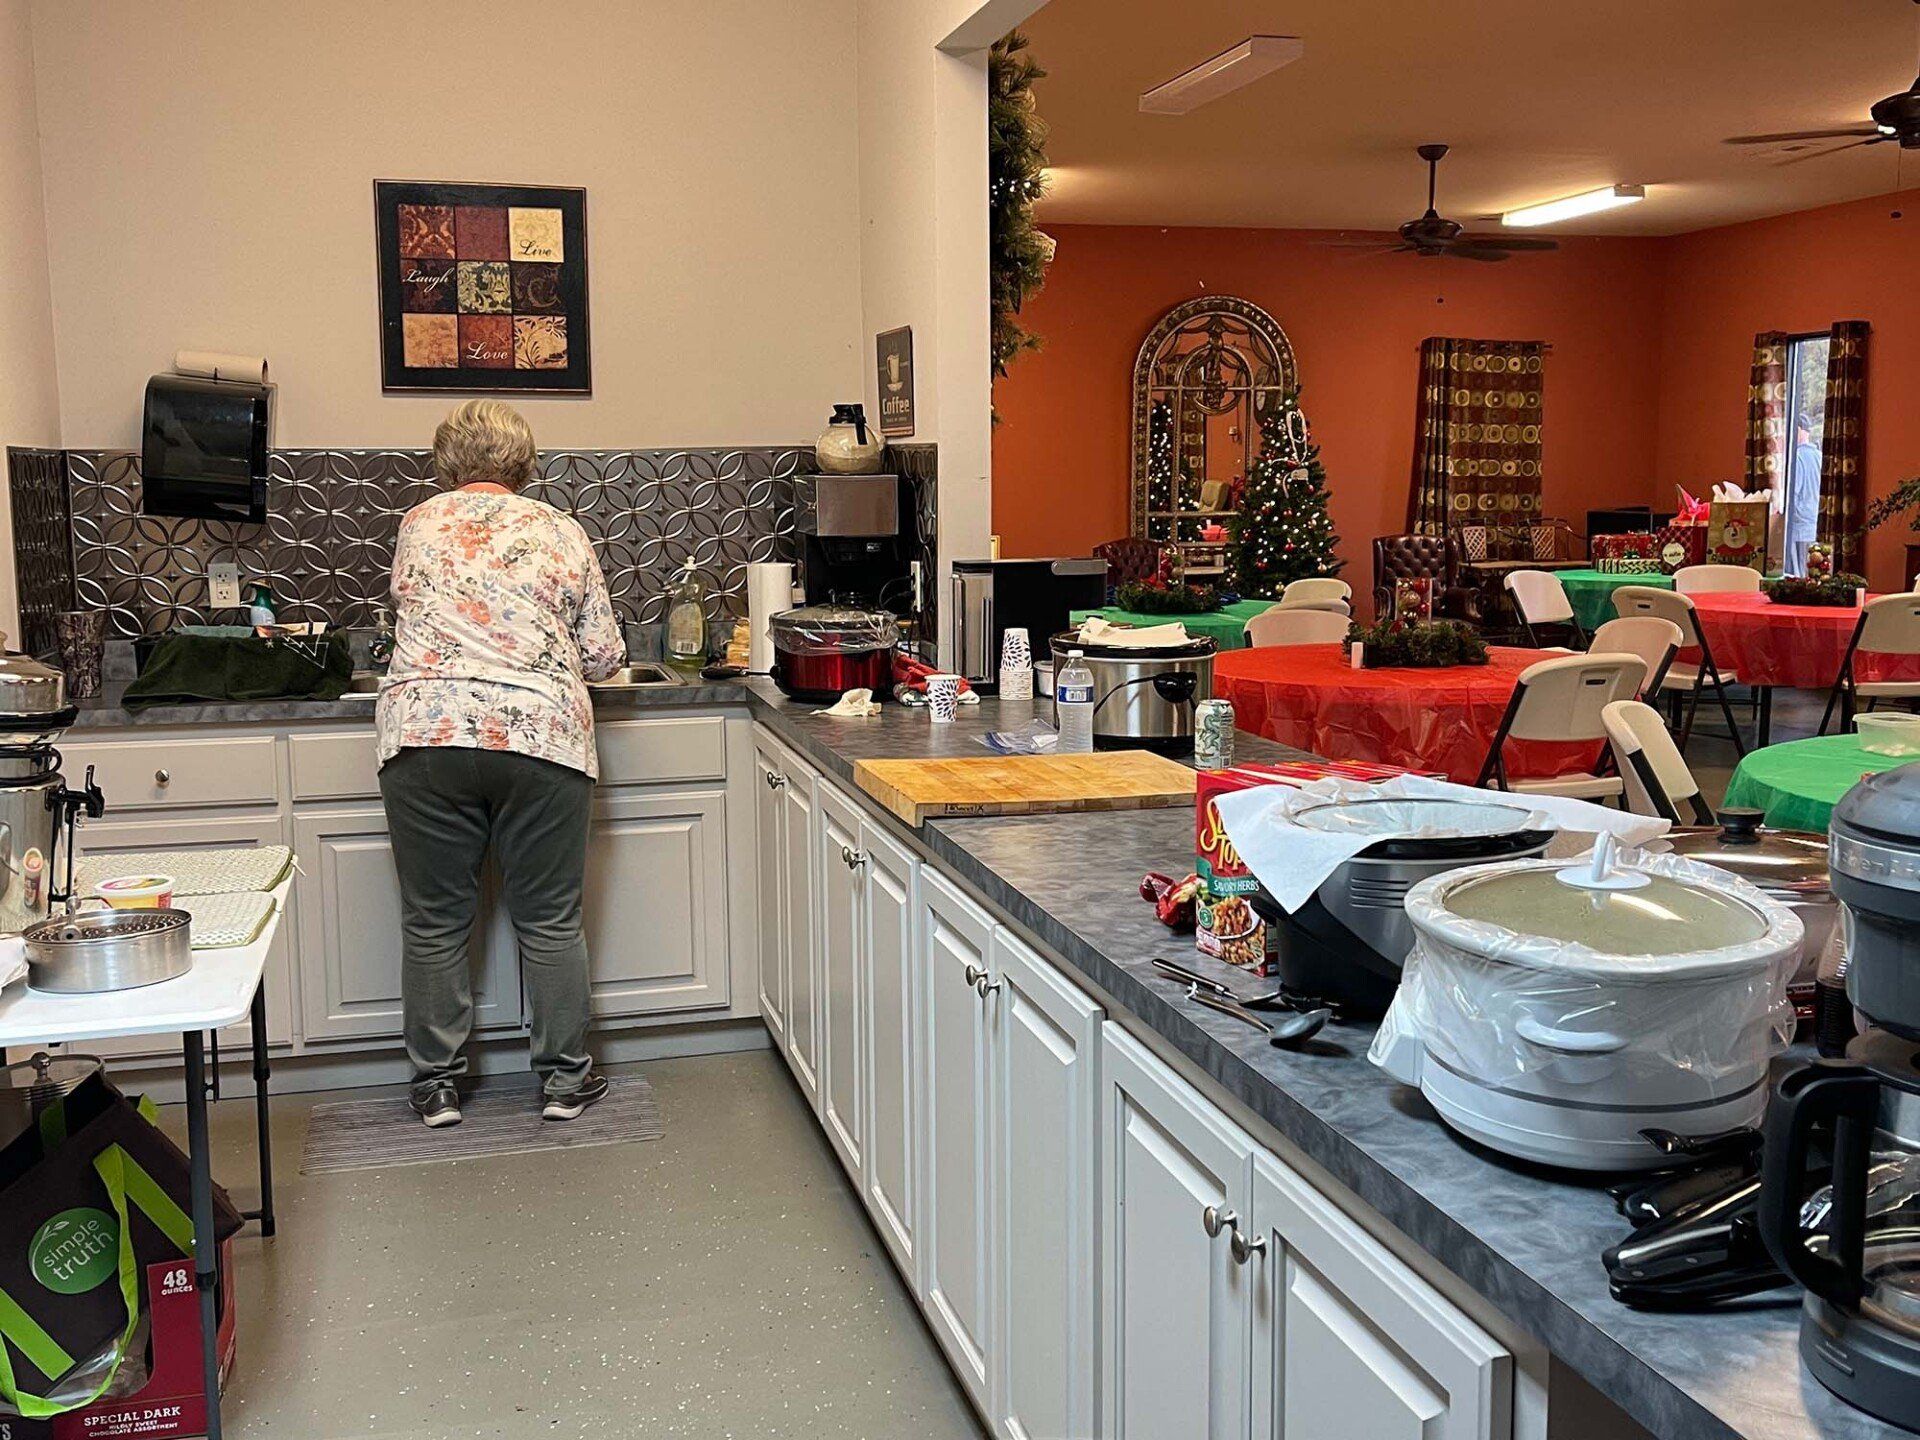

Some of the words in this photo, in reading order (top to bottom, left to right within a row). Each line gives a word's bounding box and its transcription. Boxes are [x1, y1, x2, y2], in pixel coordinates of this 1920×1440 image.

[519, 240, 552, 257] Live
[402, 267, 455, 292] Laugh
[465, 341, 508, 360] Love
[882, 396, 910, 415] Coffee
[1213, 880, 1237, 892] SAVORY
[1237, 879, 1260, 892] HERBS
[43, 1220, 100, 1267] simple
[53, 1232, 114, 1280] truth
[163, 1269, 188, 1288] 48
[84, 1411, 140, 1427] SPECIAL
[143, 1406, 182, 1419] DARK
[135, 1419, 159, 1427] SWEET
[88, 1428, 131, 1438] CHOCOLATE
[133, 1422, 179, 1433] ASSORTMENT
